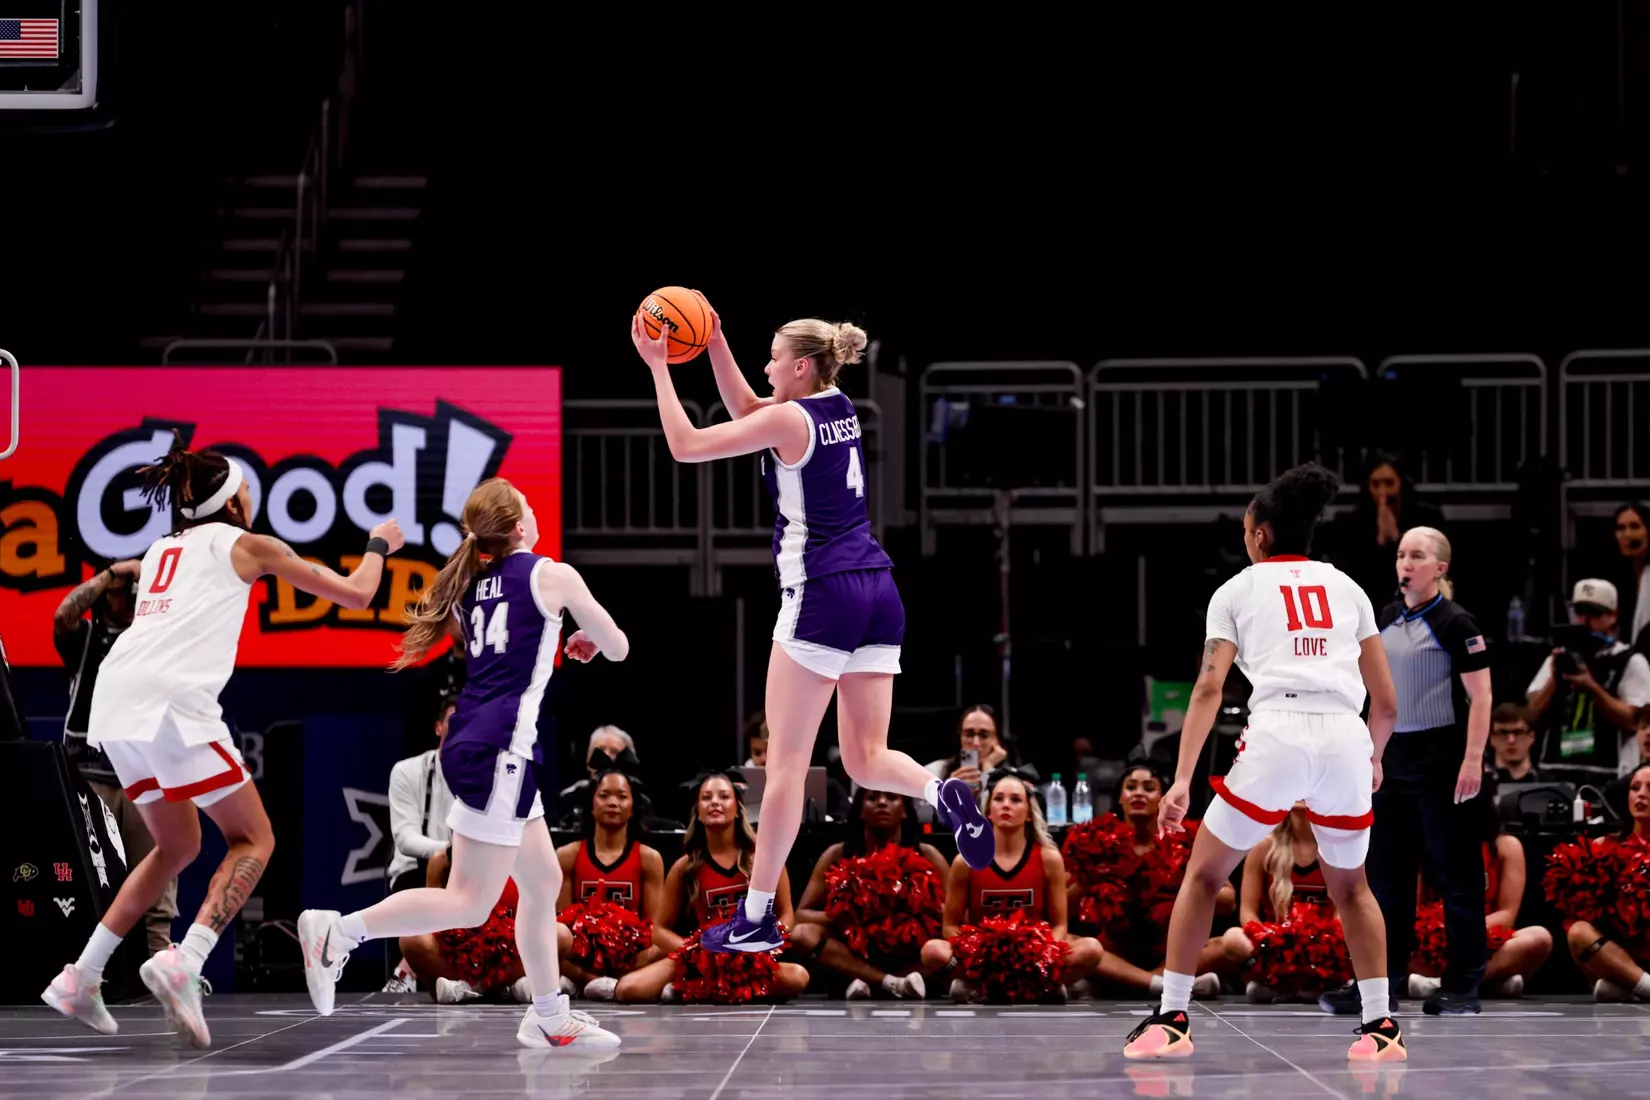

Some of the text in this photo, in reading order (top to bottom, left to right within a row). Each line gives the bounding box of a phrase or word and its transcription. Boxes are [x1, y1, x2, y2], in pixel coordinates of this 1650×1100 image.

[643, 298, 679, 334] Wilson
[846, 446, 864, 498] 4
[149, 547, 184, 593] 0
[475, 575, 504, 602] HEAL
[470, 602, 510, 658] 34
[1279, 585, 1333, 631] 10
[1294, 637, 1327, 656] LOVE
